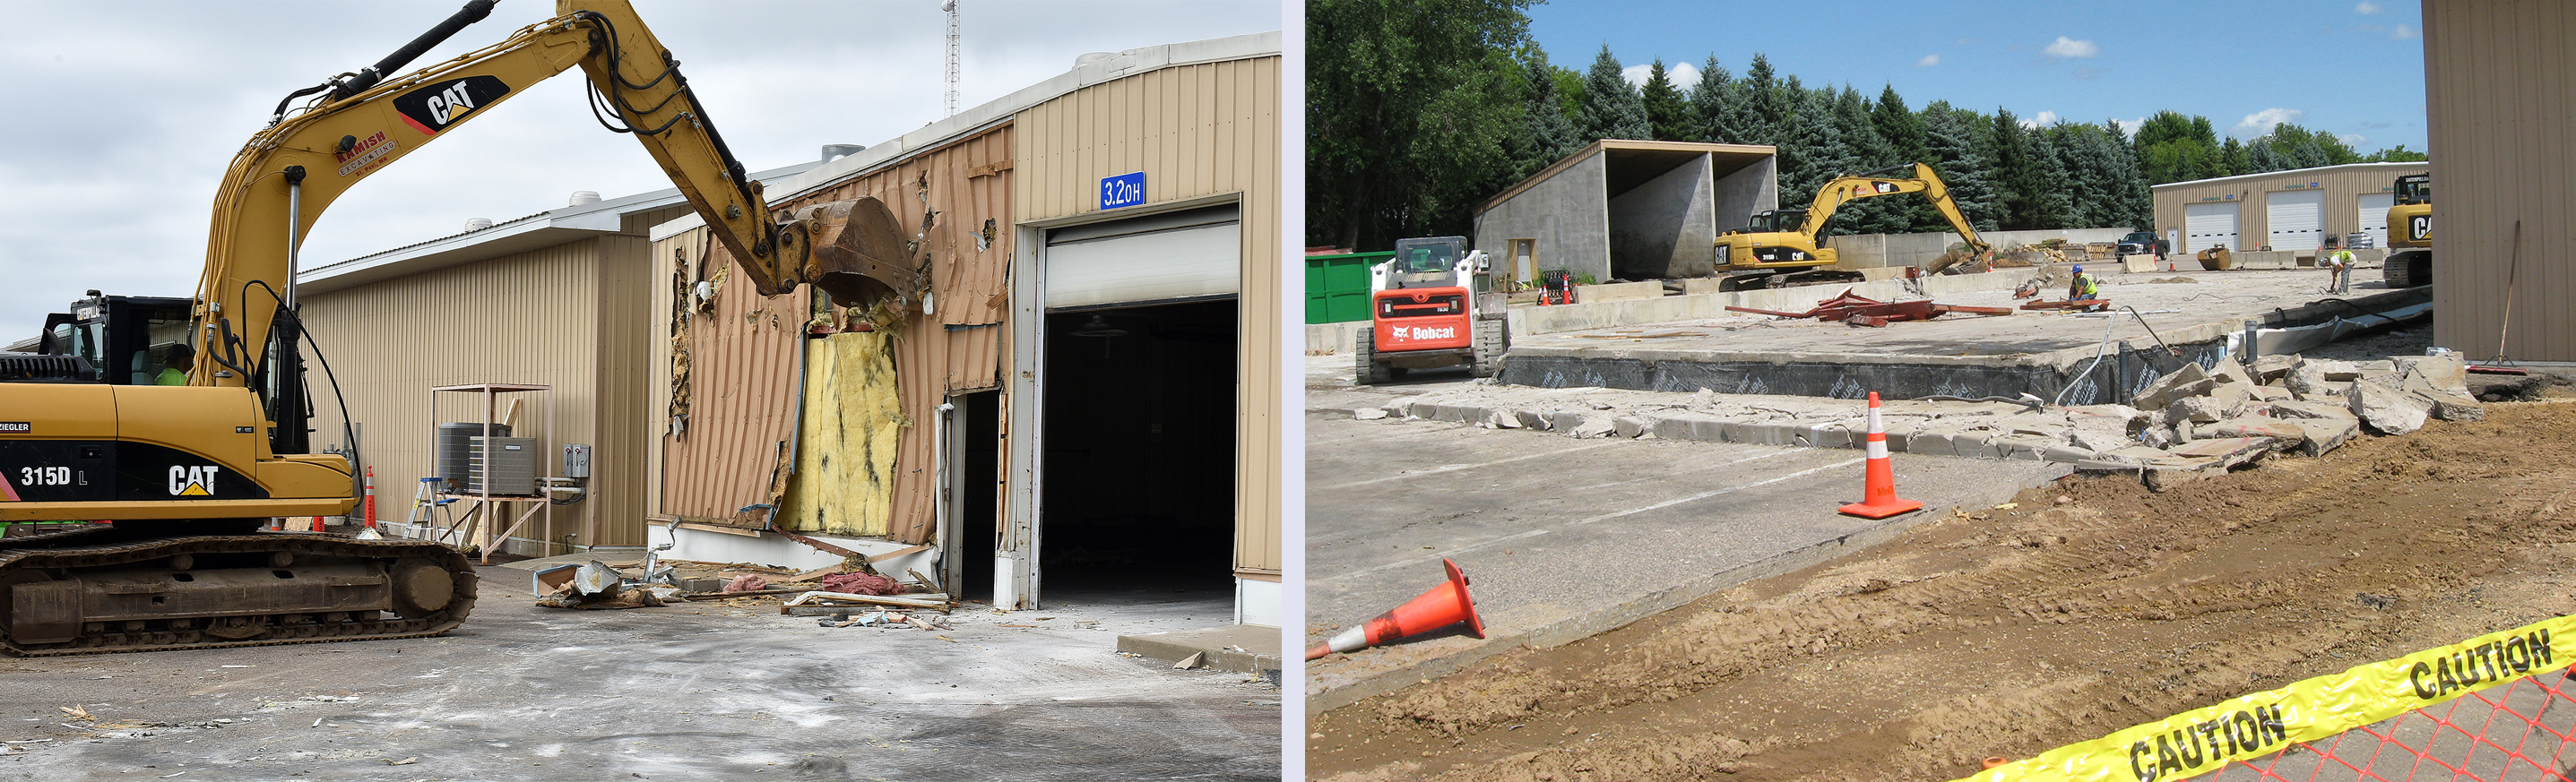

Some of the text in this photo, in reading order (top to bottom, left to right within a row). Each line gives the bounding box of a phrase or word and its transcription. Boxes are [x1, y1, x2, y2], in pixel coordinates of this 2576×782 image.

[427, 79, 475, 125] CAT
[340, 142, 394, 176] EXCAVATING
[377, 156, 388, 165] MN
[1878, 183, 1891, 193] CAT
[1715, 245, 1728, 264] CAT
[1792, 252, 1805, 262] CAT
[1413, 326, 1455, 340] Bobcat
[21, 466, 88, 486] 315D L
[169, 465, 219, 496] CAT
[2410, 628, 2553, 700] CAUTION
[2130, 703, 2286, 782] CAUTION
